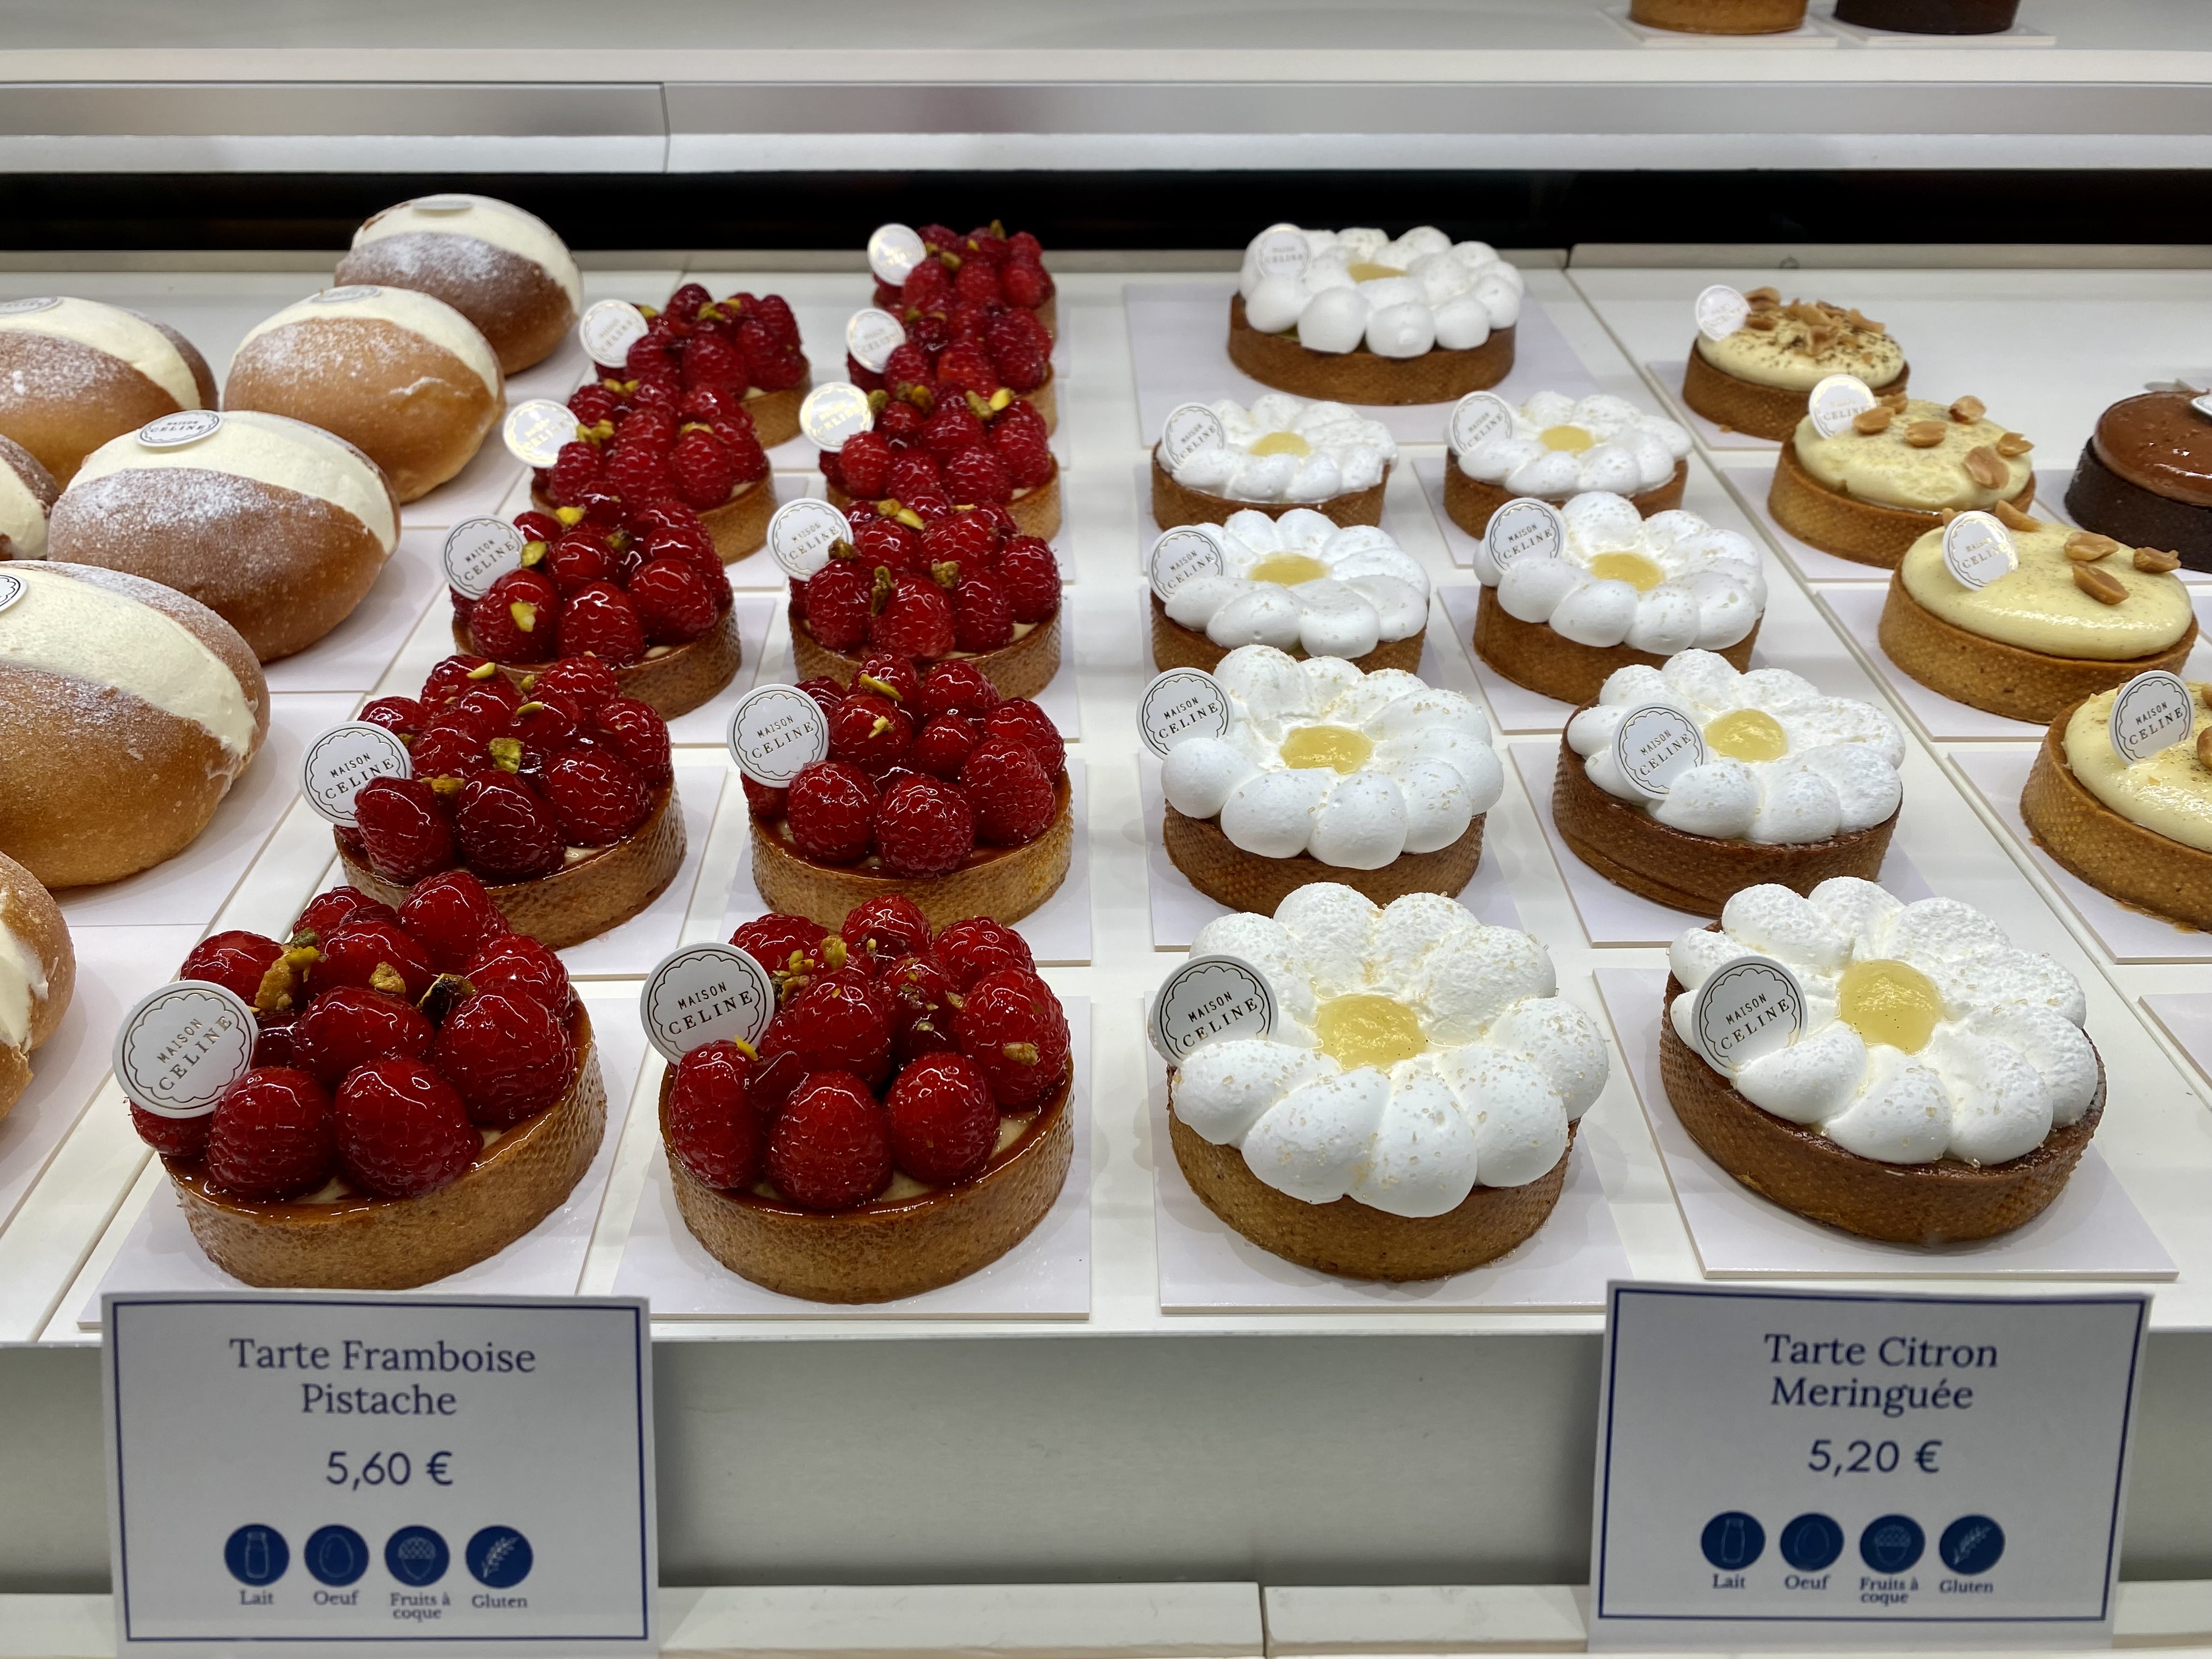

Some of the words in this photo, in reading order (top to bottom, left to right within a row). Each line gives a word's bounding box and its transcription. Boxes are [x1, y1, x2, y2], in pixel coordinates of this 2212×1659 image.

[150, 424, 205, 432] CELINE
[1180, 425, 1216, 459] CELINE
[1468, 414, 1503, 447] CELINE
[788, 526, 839, 560] CELINE
[792, 522, 820, 543] MAISON
[1503, 528, 1553, 559] CELINE
[1508, 523, 1537, 542] MAISON
[464, 541, 515, 581] CELINE
[466, 539, 495, 563] MAISON
[1169, 550, 1197, 572] MAISON
[1167, 553, 1213, 589] CELINE
[1158, 703, 1218, 739] CELINE
[1164, 697, 1199, 718] MAISON
[2136, 702, 2166, 725] MAISON
[752, 721, 814, 759] CELINE
[757, 715, 793, 738] MAISON
[1640, 730, 1672, 755] MAISON
[2130, 707, 2183, 746] CELINE
[330, 753, 371, 778] MAISON
[1640, 733, 1691, 776] CELINE
[325, 758, 394, 799] CELINE
[678, 981, 727, 1009] MAISON
[1188, 991, 1232, 1023] MAISON
[1725, 993, 1767, 1025] MAISON
[669, 991, 753, 1035] CELINE
[1183, 998, 1257, 1047] CELINE
[1721, 998, 1789, 1049] CELINE
[157, 1019, 202, 1063] MAISON
[159, 1016, 232, 1091] CELINE
[230, 1338, 329, 1370] Tarte
[342, 1341, 536, 1373] Framboise
[1764, 1334, 1865, 1366] Tarte
[1878, 1336, 1998, 1368] Citron
[301, 1384, 457, 1416] Pistache
[1771, 1376, 1973, 1417] Meringuée
[326, 1452, 410, 1492] 5,60
[427, 1452, 453, 1485] €
[1808, 1440, 1900, 1476] 5,20
[1915, 1441, 1942, 1472] €
[1712, 1574, 1746, 1589] Lait
[1785, 1575, 1830, 1591] Oeuf
[1860, 1577, 1905, 1592] Fruits
[1910, 1578, 1919, 1592] à
[1939, 1579, 1994, 1594] Gluten
[240, 1590, 274, 1606] Lait
[313, 1590, 359, 1606] Oeuf
[391, 1593, 437, 1607] Fruits
[442, 1593, 450, 1607] à
[393, 1607, 442, 1621] coque
[472, 1594, 528, 1609] Gluten
[1860, 1592, 1909, 1606] coque
